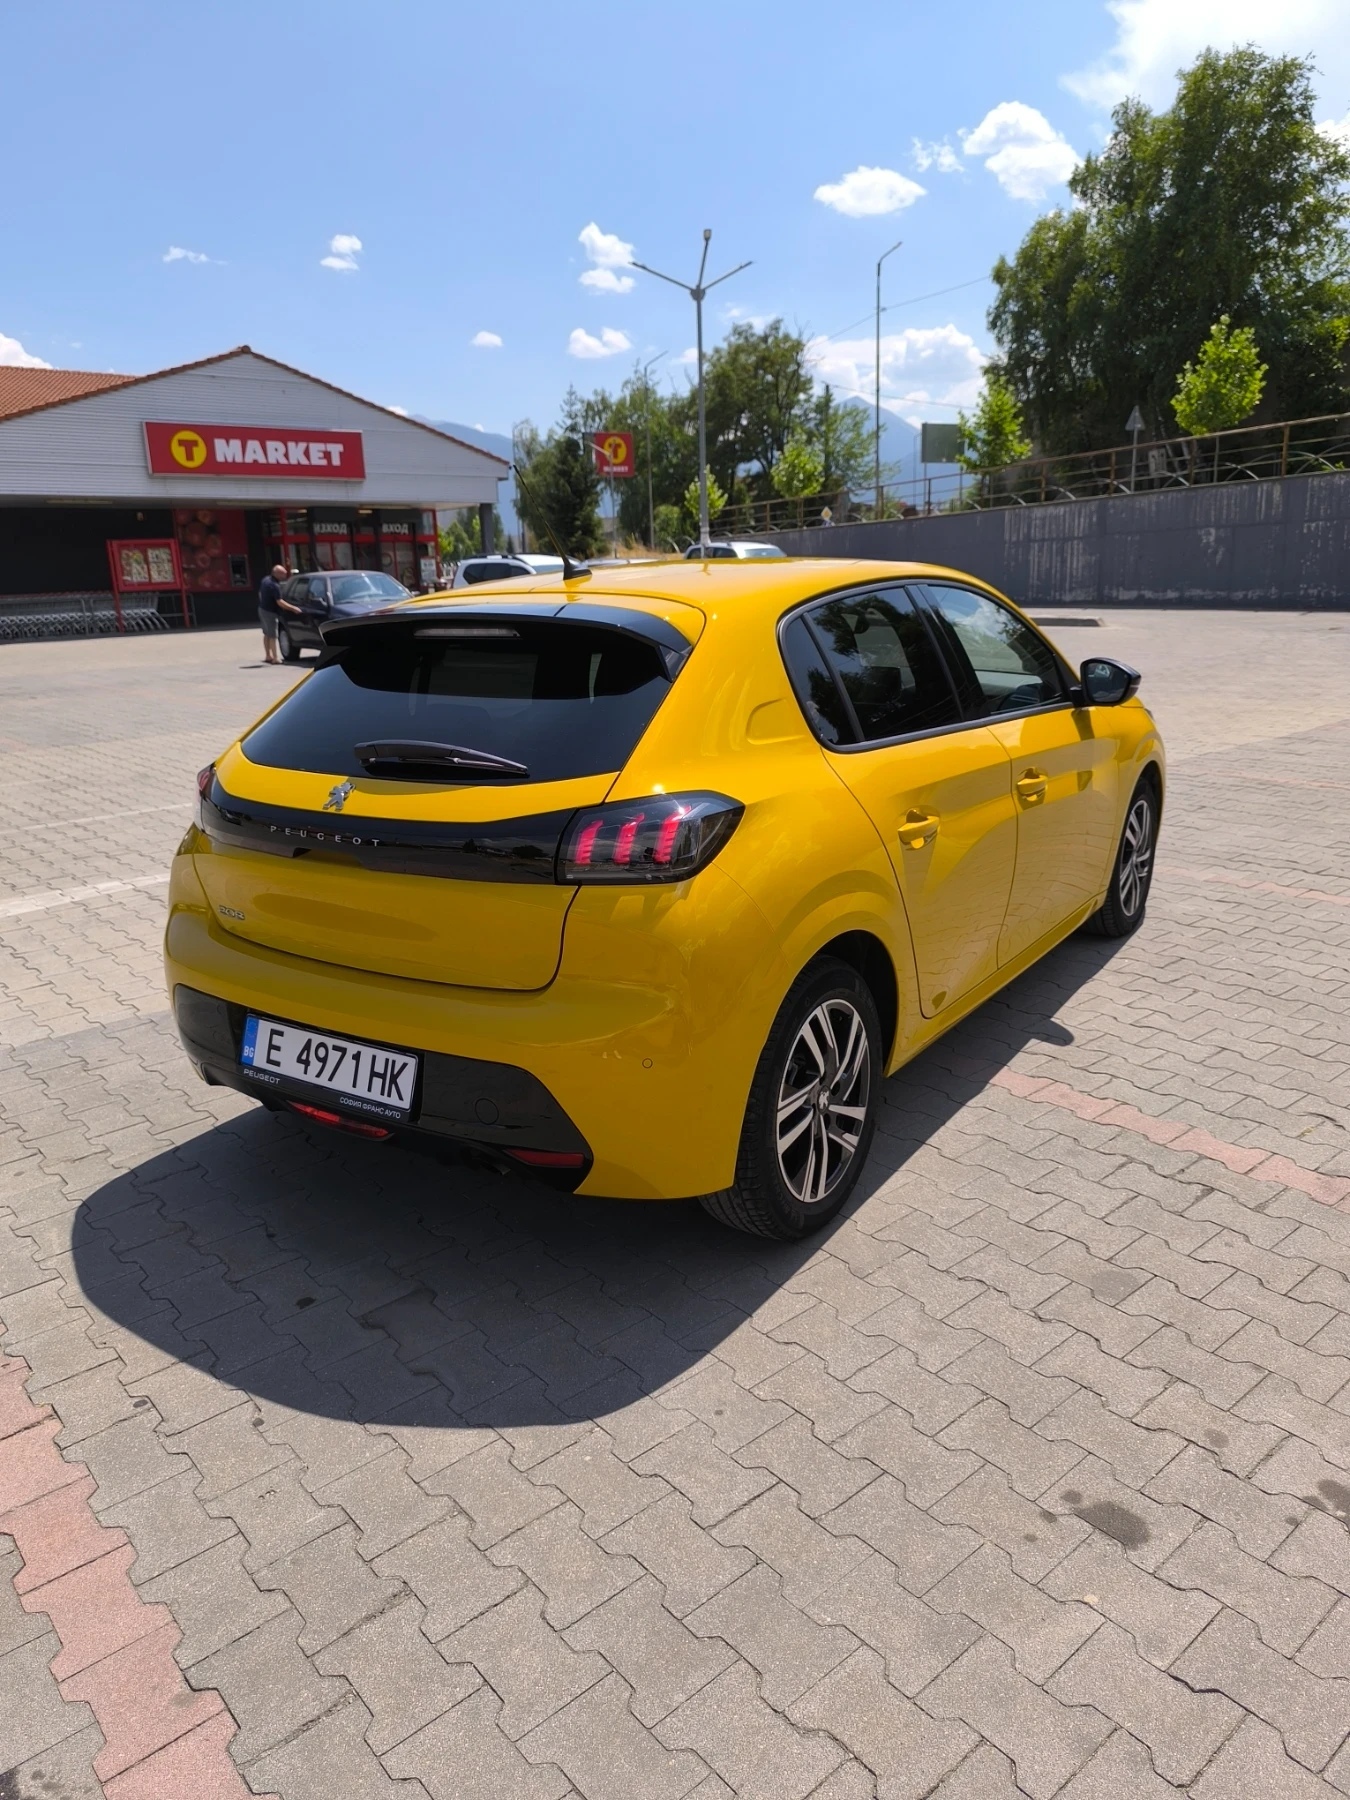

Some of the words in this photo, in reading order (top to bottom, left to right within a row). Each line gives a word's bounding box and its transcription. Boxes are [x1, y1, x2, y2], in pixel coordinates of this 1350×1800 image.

[177, 439, 199, 461] T
[213, 438, 344, 467] MARKET
[313, 522, 347, 535] ИЗХОД
[382, 523, 409, 534] ВХОД
[270, 825, 380, 847] PEUGEOT
[243, 1045, 254, 1058] BG
[265, 1028, 285, 1067] E
[243, 1068, 281, 1085] PEUGEOT
[339, 1096, 362, 1108] СОФИЯ
[362, 1103, 385, 1115] ФРАНС
[384, 1109, 401, 1119] АУТО
